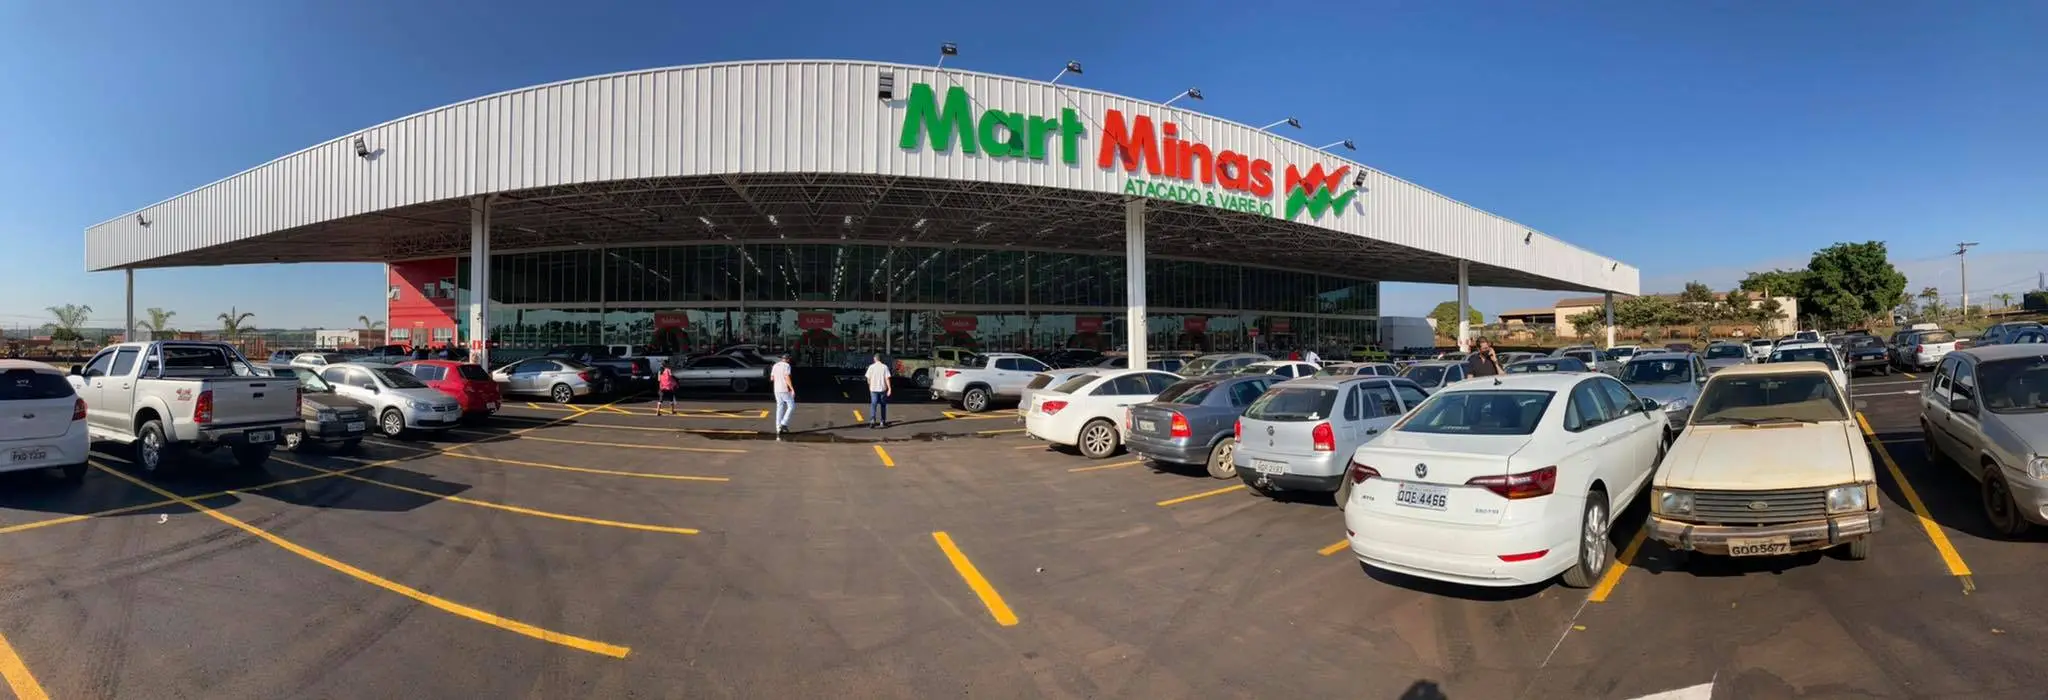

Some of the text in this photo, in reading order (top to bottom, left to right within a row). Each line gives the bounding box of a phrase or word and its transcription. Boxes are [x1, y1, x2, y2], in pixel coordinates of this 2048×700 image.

[899, 83, 1273, 198] Mart Minas
[1124, 178, 1273, 217] ATACADO & VAREJO
